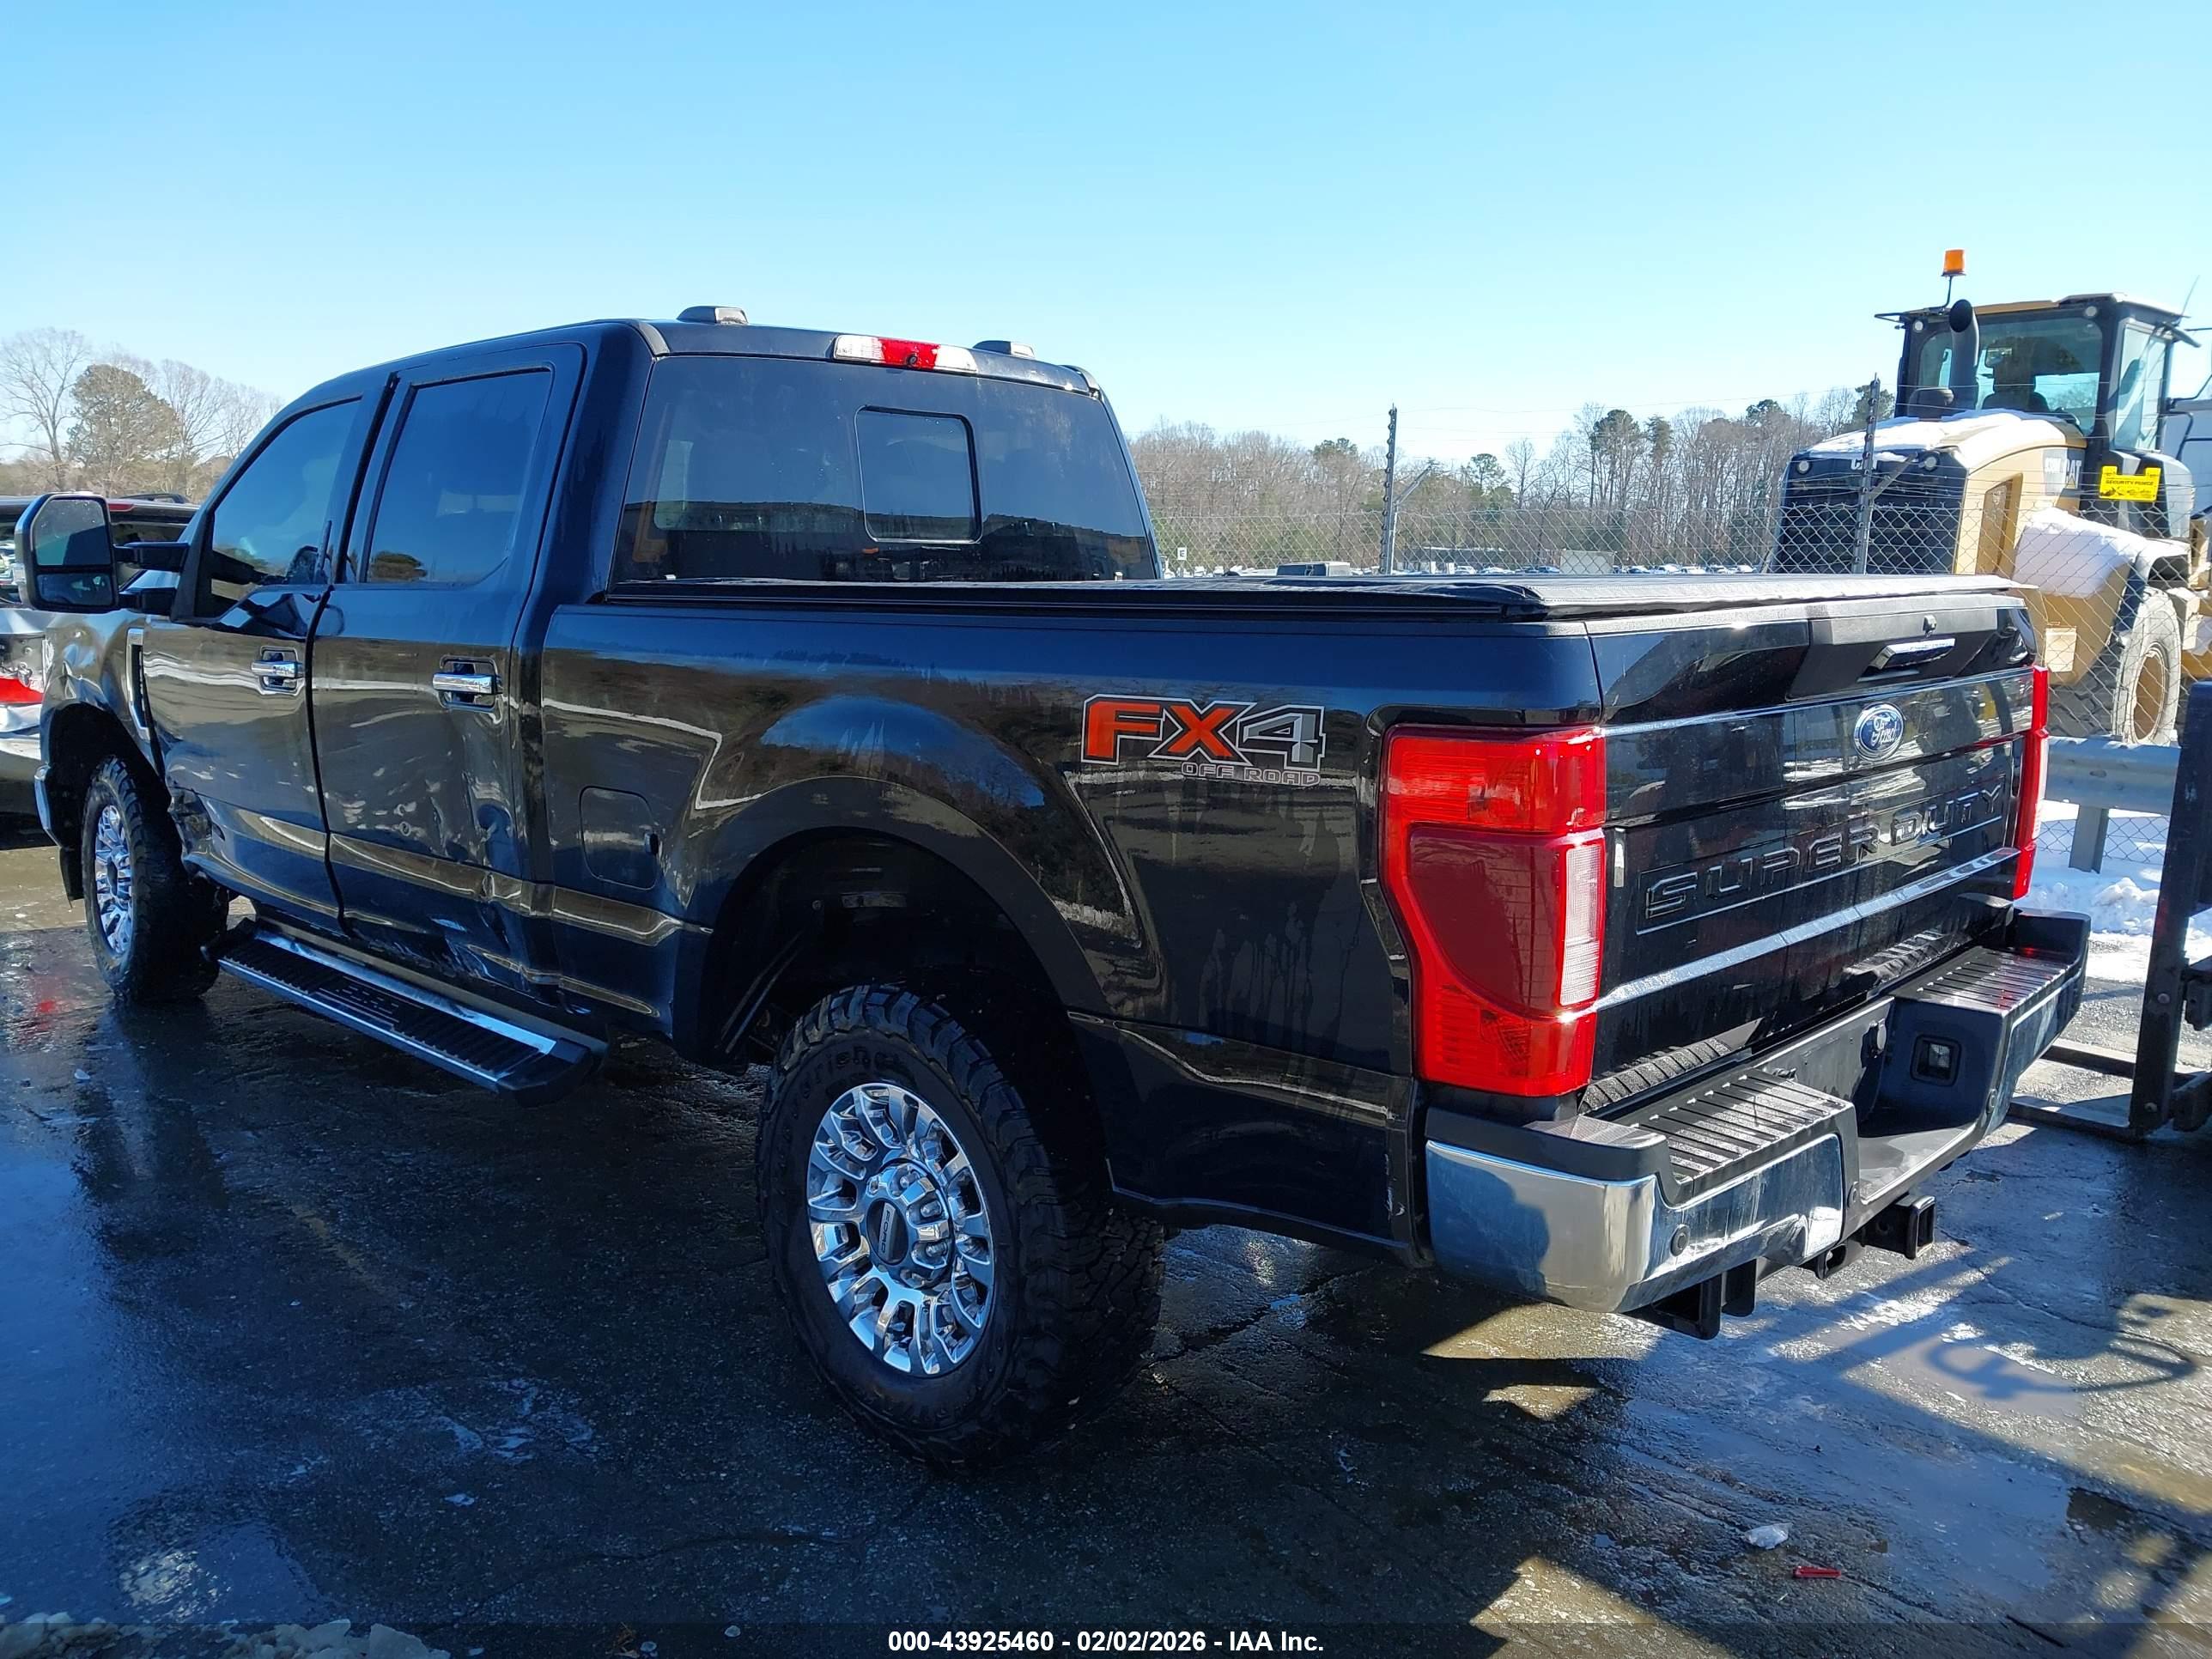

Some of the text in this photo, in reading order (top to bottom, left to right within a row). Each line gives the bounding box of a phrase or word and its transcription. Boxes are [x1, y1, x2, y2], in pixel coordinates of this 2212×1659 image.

[1081, 694, 1326, 772] FX4
[1181, 762, 1321, 787] OFF ROAD
[1644, 782, 2003, 920] SUPER DUTY
[881, 1209, 890, 1254] FORD
